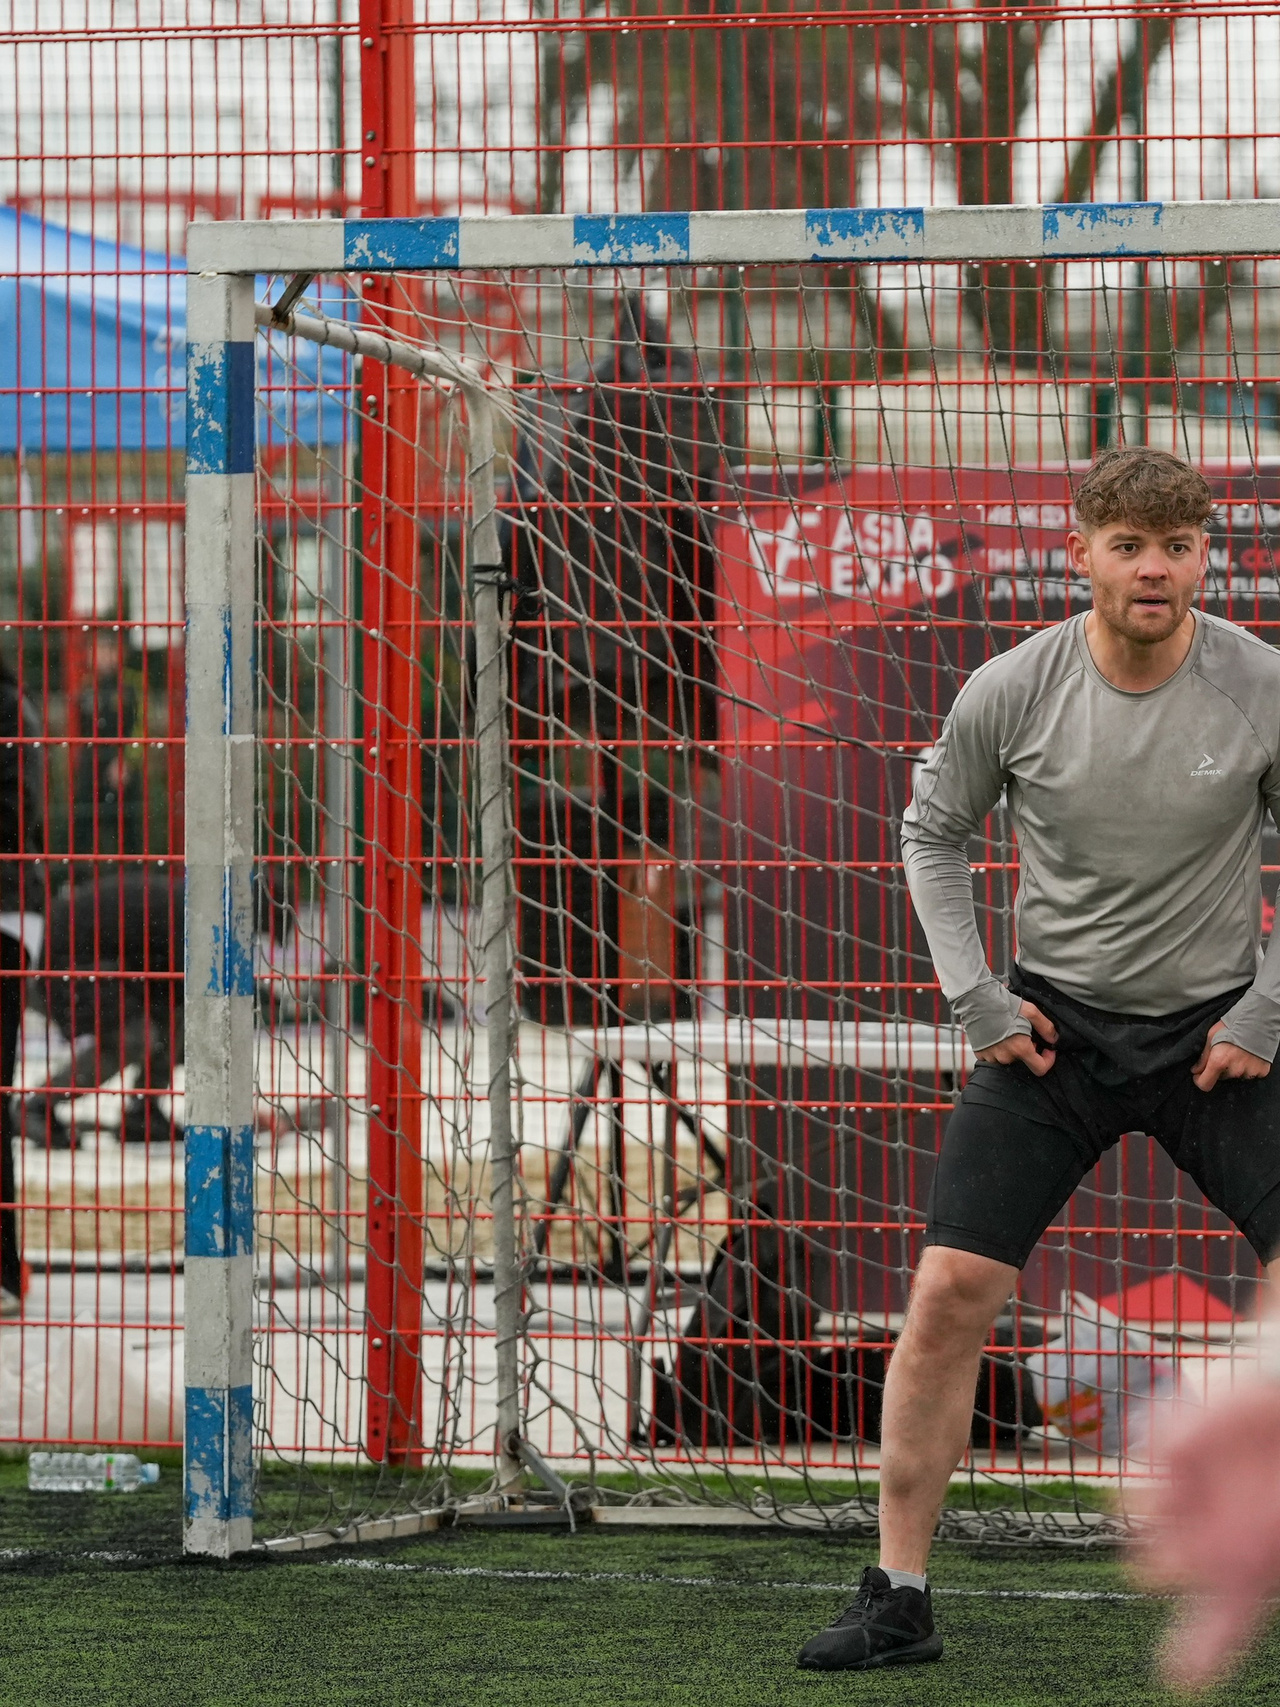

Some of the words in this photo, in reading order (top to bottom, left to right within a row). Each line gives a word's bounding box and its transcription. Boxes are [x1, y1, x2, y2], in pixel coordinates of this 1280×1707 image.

[831, 512, 940, 554] ASIA
[831, 554, 955, 598] EXPO
[1190, 769, 1223, 777] DEMIX
